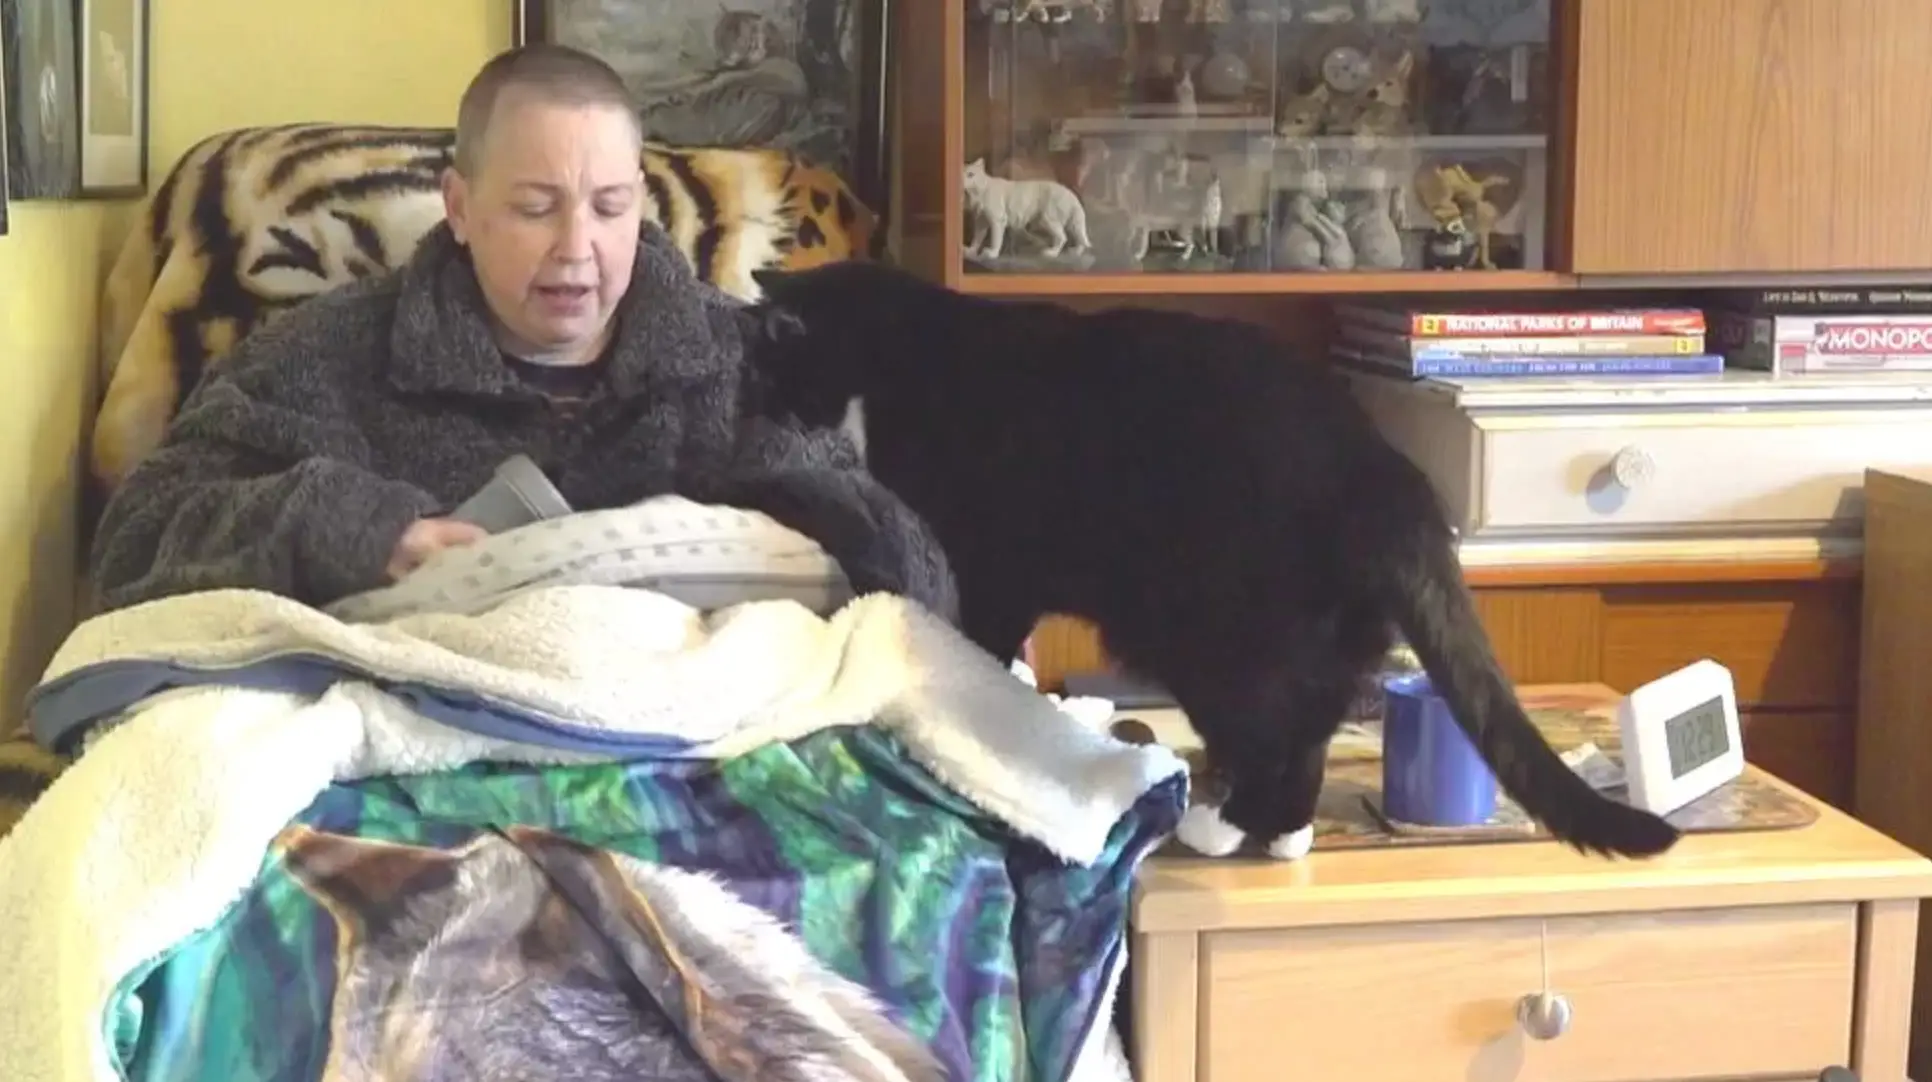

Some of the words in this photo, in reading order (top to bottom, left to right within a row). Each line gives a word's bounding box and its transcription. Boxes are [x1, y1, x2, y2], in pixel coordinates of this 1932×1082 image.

[1446, 315, 1511, 331] NATIONAL
[1520, 315, 1563, 330] PARKS
[1567, 315, 1586, 330] OF
[1590, 315, 1643, 330] BRITAIN
